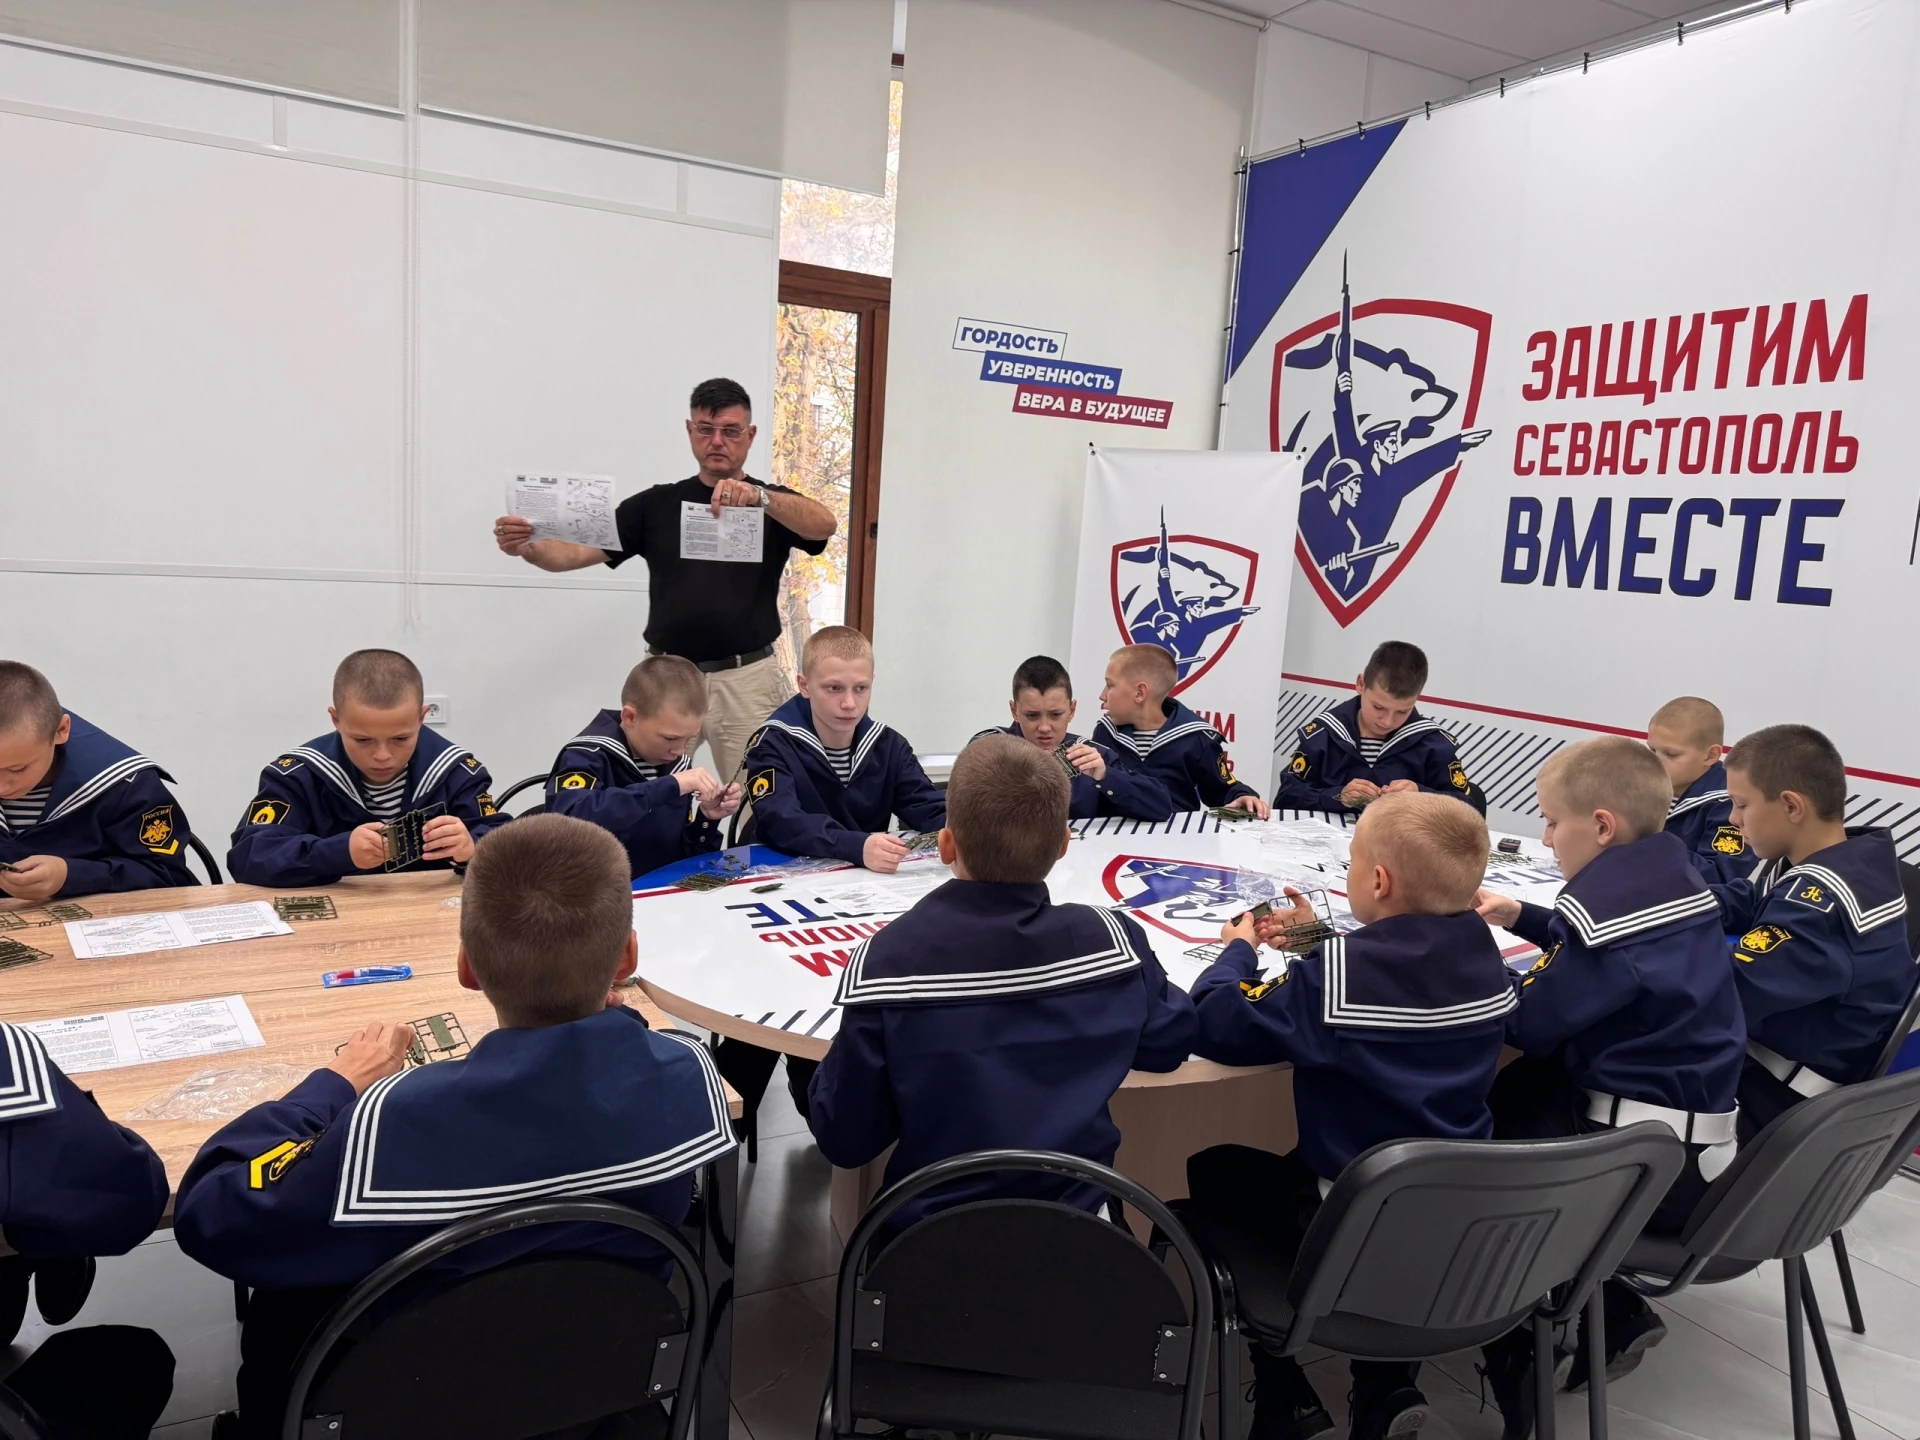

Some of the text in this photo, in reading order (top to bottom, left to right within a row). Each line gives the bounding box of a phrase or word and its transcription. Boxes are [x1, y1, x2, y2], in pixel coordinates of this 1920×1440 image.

[960, 326, 1059, 354] ГОРДОСТЬ
[1521, 293, 1869, 406] ЗАЩИТИМ
[988, 359, 1115, 390] УВЕРЕННОСТЬ
[1018, 392, 1166, 423] ВЕРА В БУДУЩЕЕ
[1513, 410, 1859, 476] СЕВАСТОПОЛЬ
[1500, 496, 1845, 607] ВМЕСТЕ
